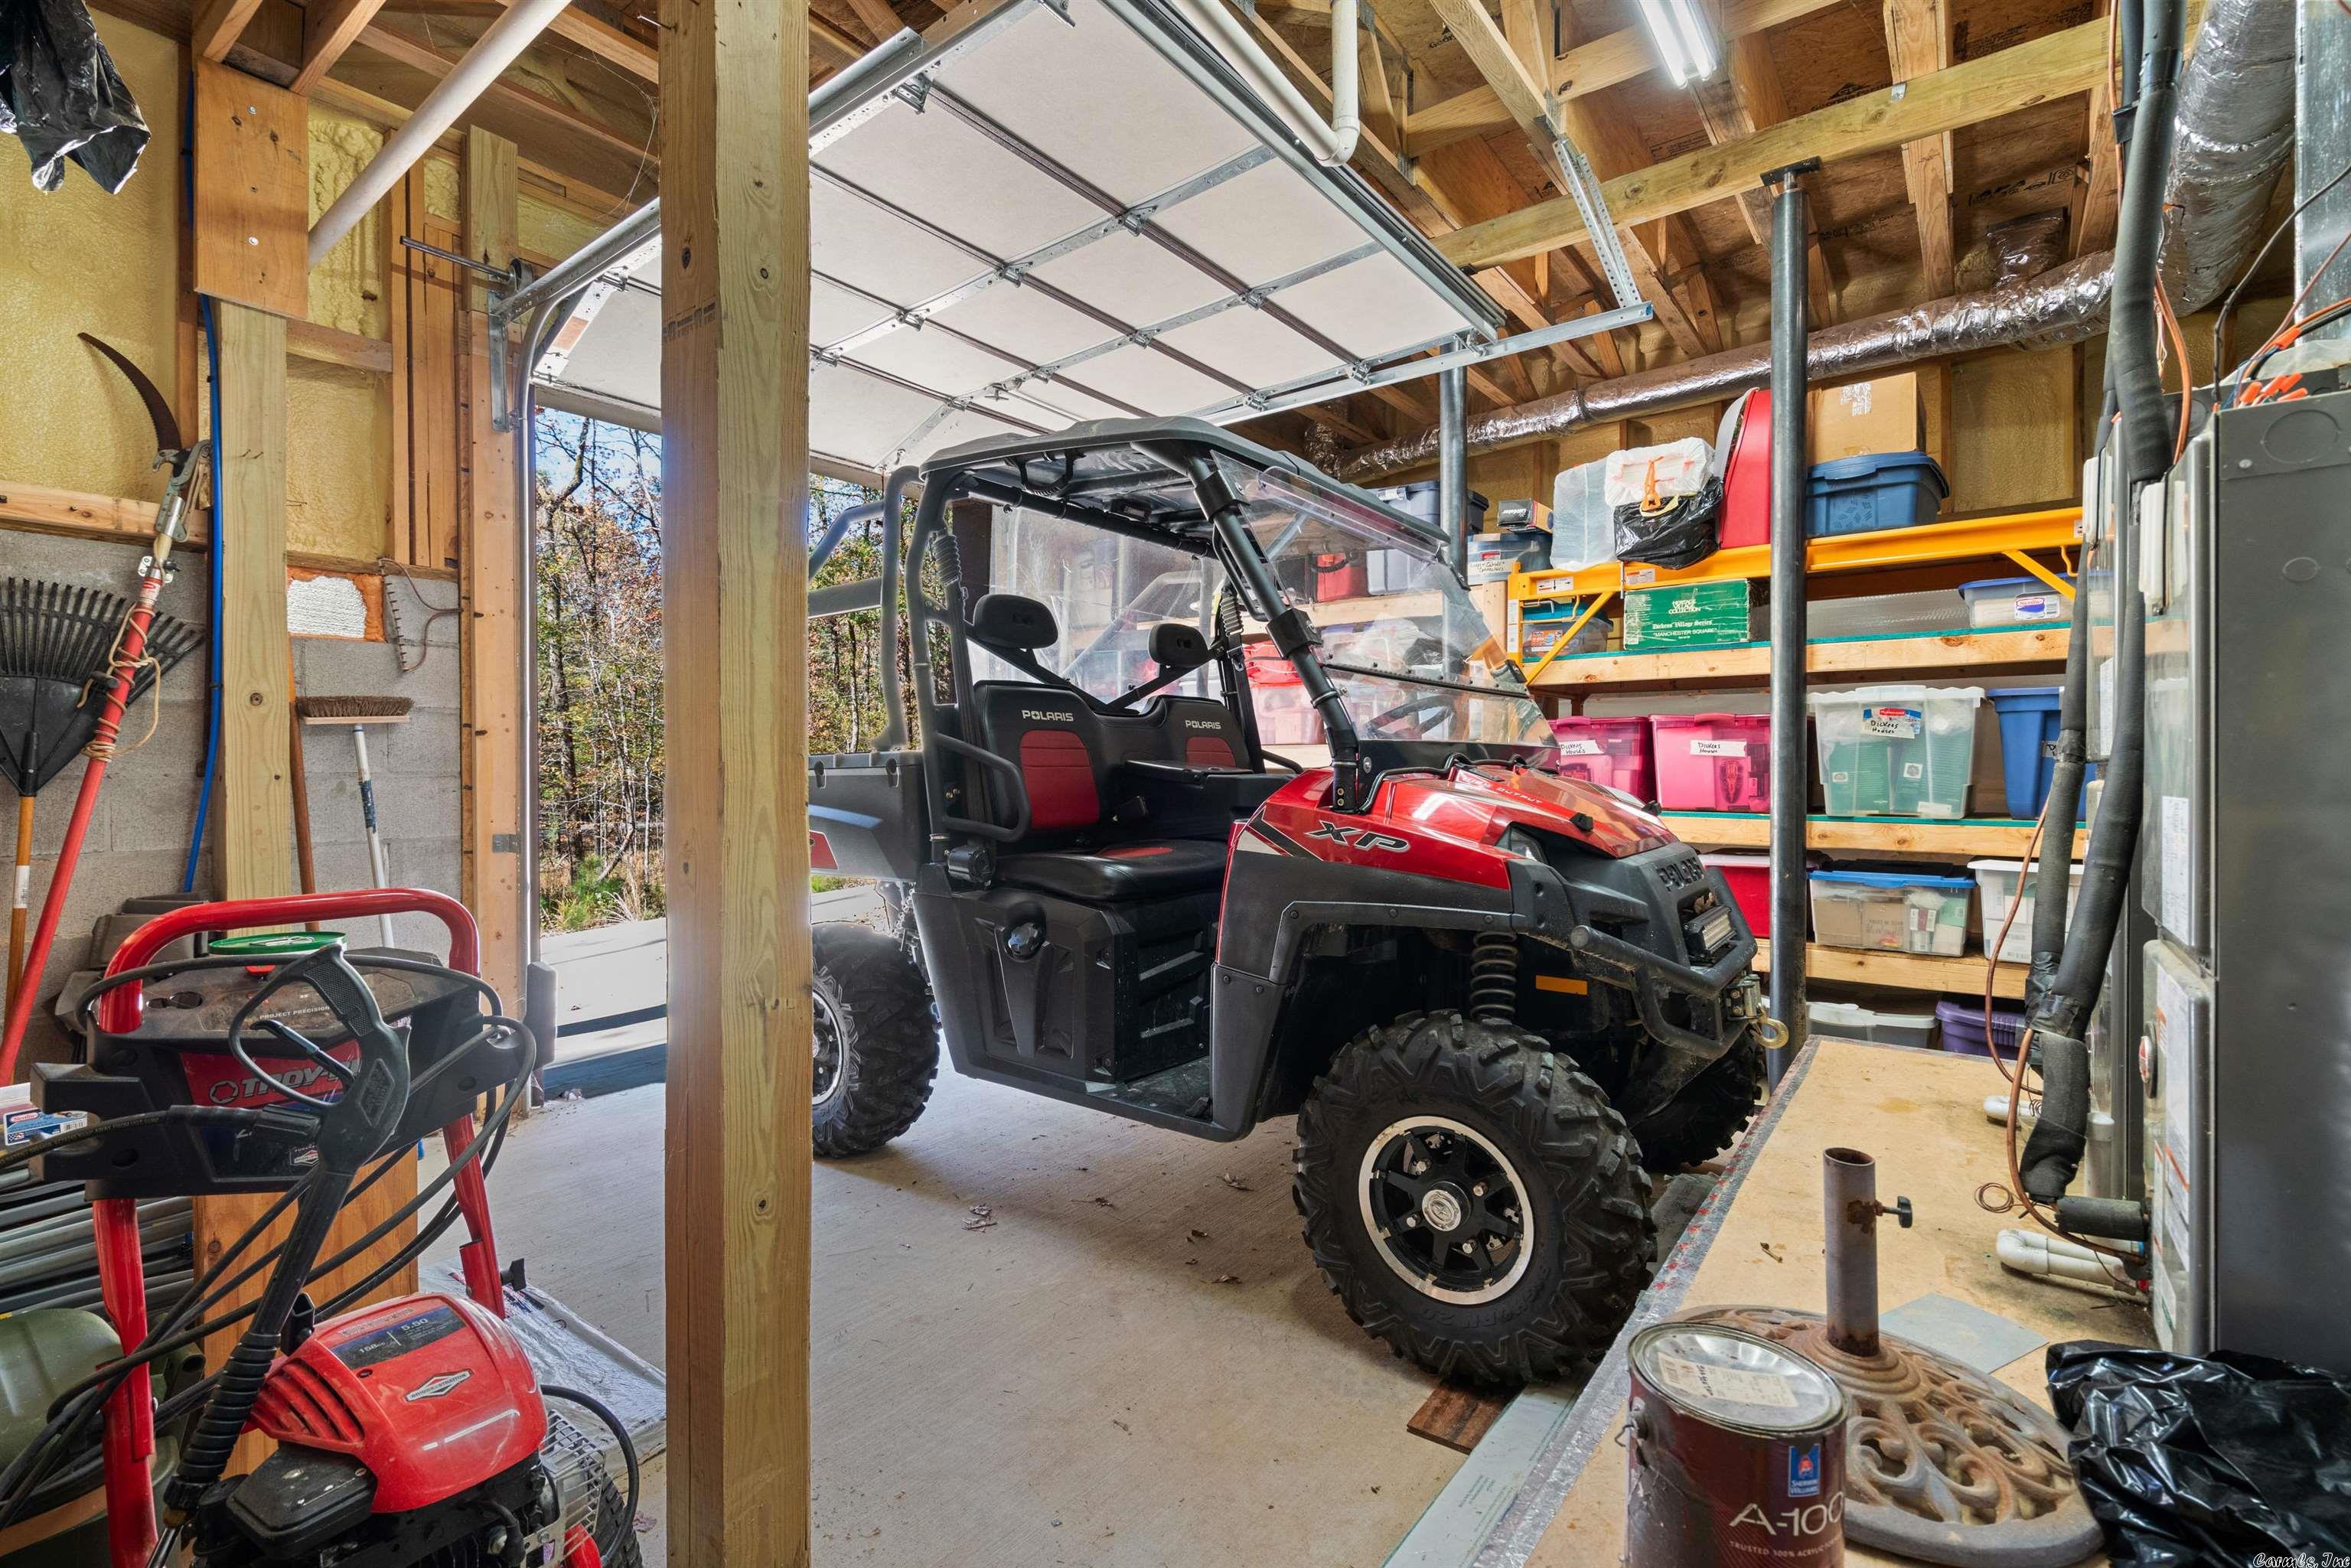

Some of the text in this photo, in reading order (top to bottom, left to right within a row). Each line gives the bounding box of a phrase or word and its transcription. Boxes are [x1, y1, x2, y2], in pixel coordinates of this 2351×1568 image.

[1022, 709, 1074, 722] POLARIS
[1185, 720, 1222, 730] POLARIS
[1495, 787, 1544, 804] OUTPUT
[1304, 820, 1411, 852] XP
[1655, 856, 1704, 893] POLARIS
[259, 1006, 331, 1020] PROJECT PRECISION
[400, 1318, 429, 1332] 5.50
[1729, 1491, 1844, 1537] A-100
[1730, 1540, 1769, 1555] TRUSTED
[1773, 1548, 1795, 1558] 100%
